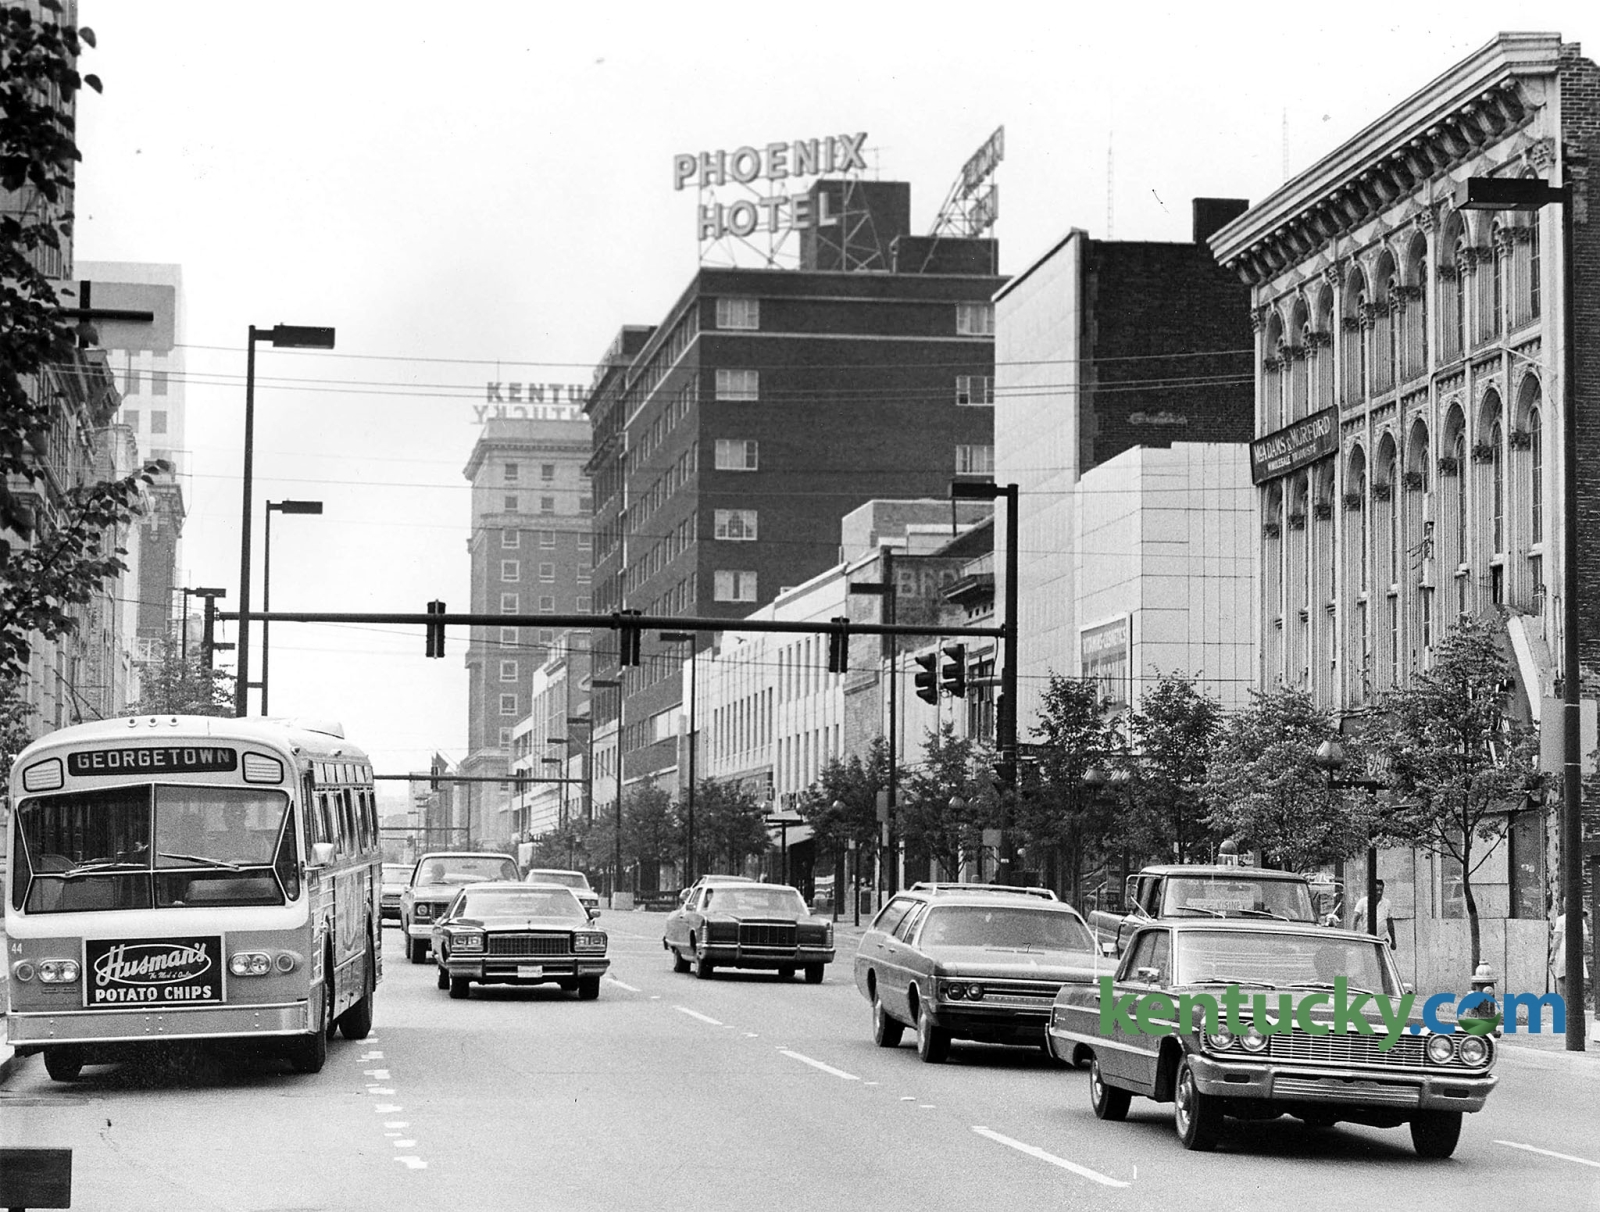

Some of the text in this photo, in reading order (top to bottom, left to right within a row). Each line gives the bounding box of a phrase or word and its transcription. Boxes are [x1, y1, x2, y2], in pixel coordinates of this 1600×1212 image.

[674, 132, 867, 190] PHOENIX
[698, 192, 839, 240] HOTEL
[77, 749, 230, 769] GEORGETOWN
[11, 943, 22, 954] 44
[96, 943, 206, 986] Husman's
[96, 985, 212, 1002] POTATO CHIPS
